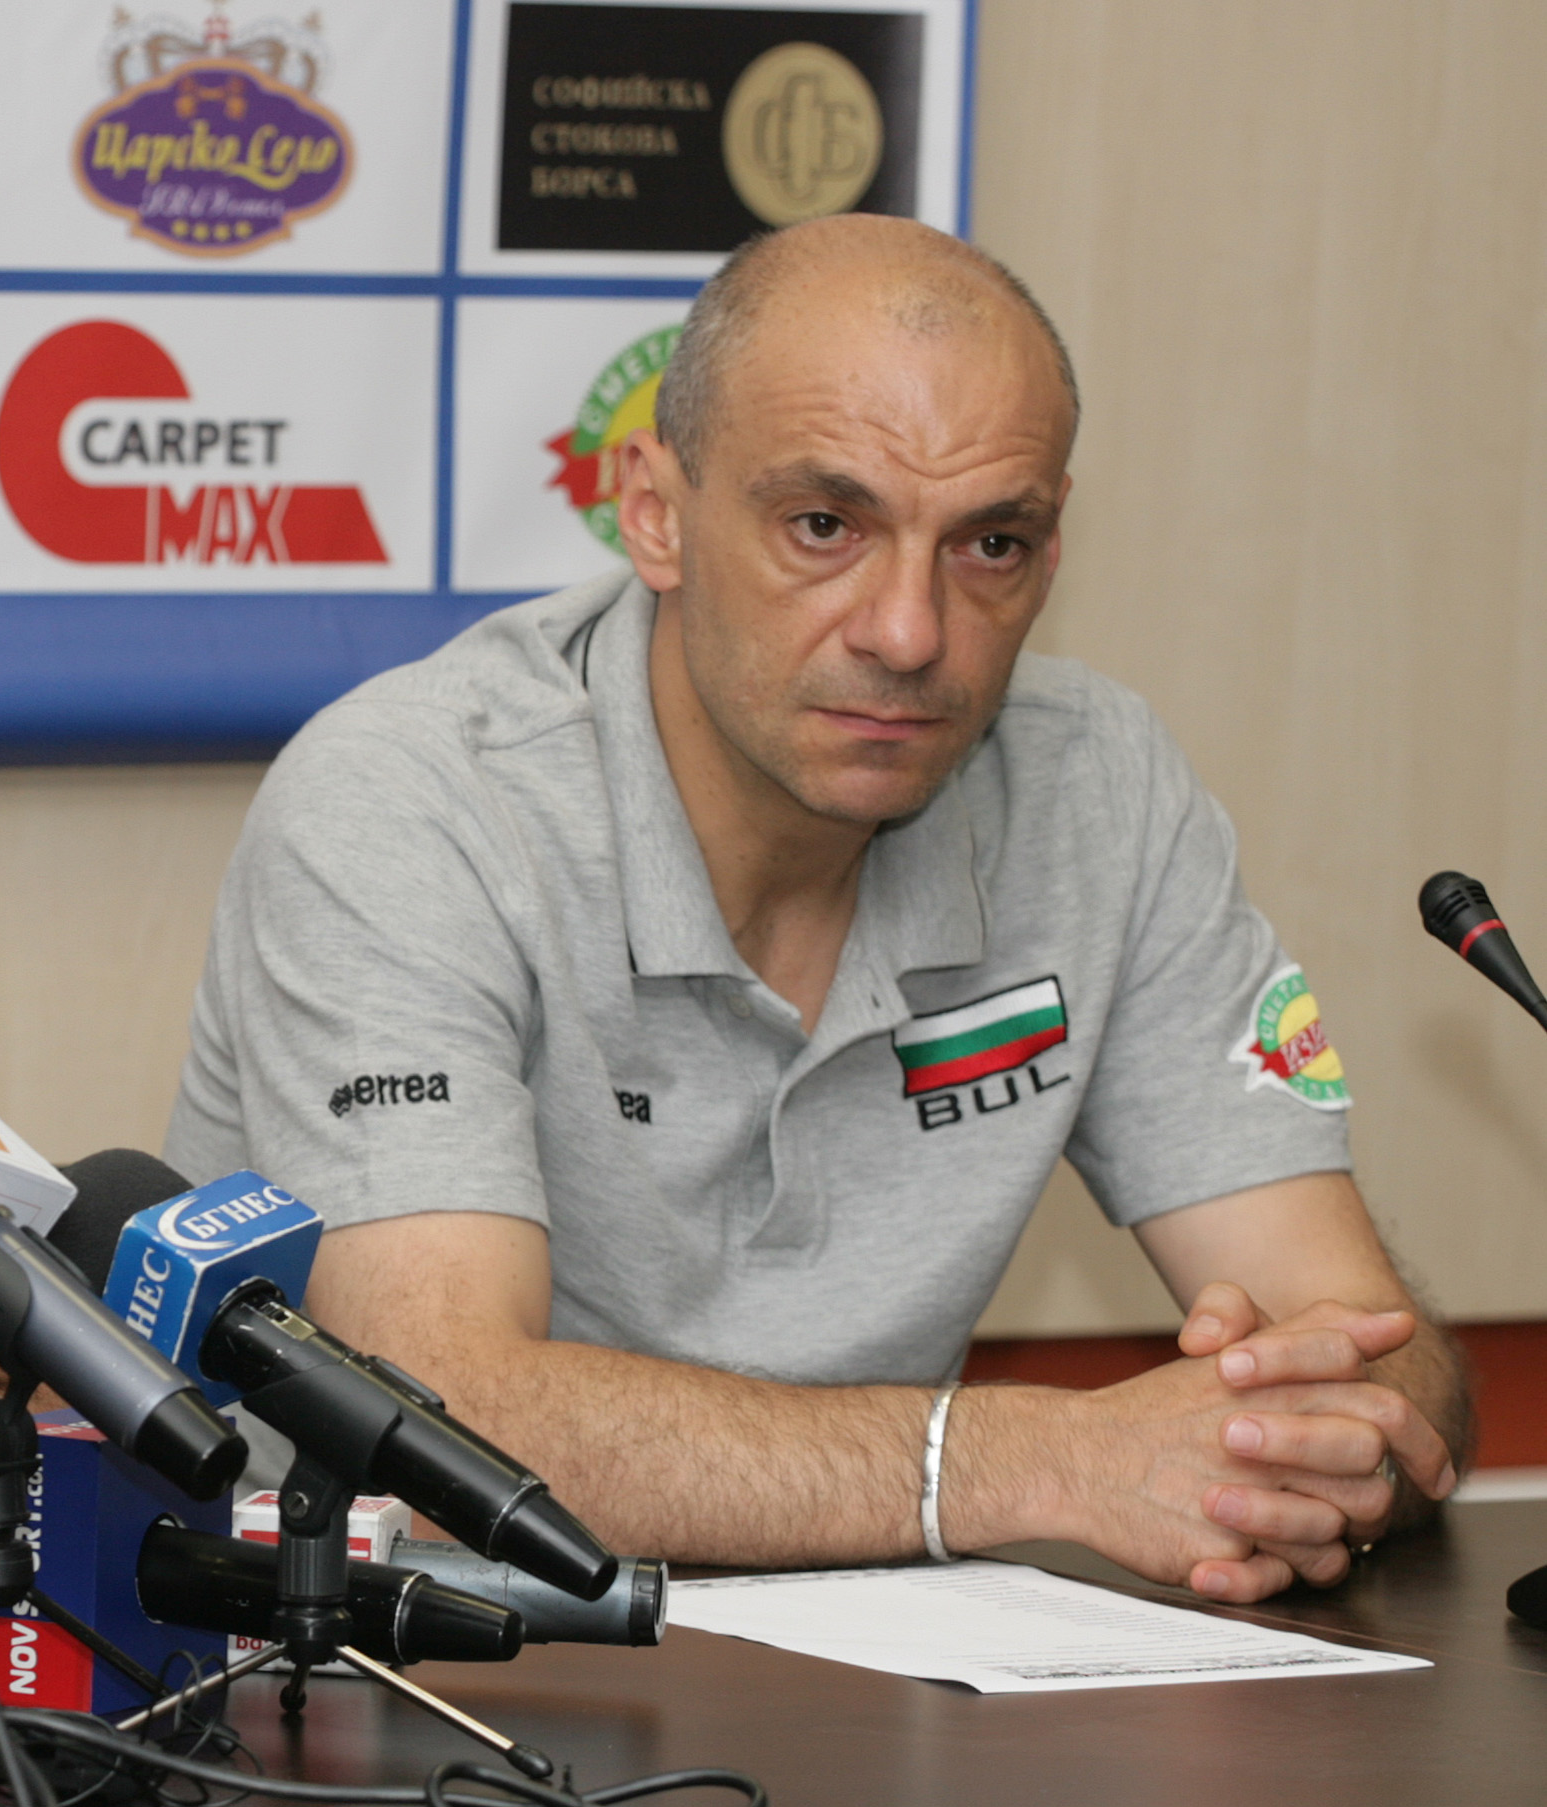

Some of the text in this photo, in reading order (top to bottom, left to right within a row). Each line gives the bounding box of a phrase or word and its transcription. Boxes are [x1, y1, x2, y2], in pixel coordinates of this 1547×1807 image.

[529, 122, 679, 157] СТОКОВА
[529, 166, 637, 199] БОРСА
[81, 420, 286, 466] CARPET
[145, 485, 296, 566] MAX
[916, 1065, 1071, 1132] BUL
[181, 1185, 295, 1240] БГНЕС
